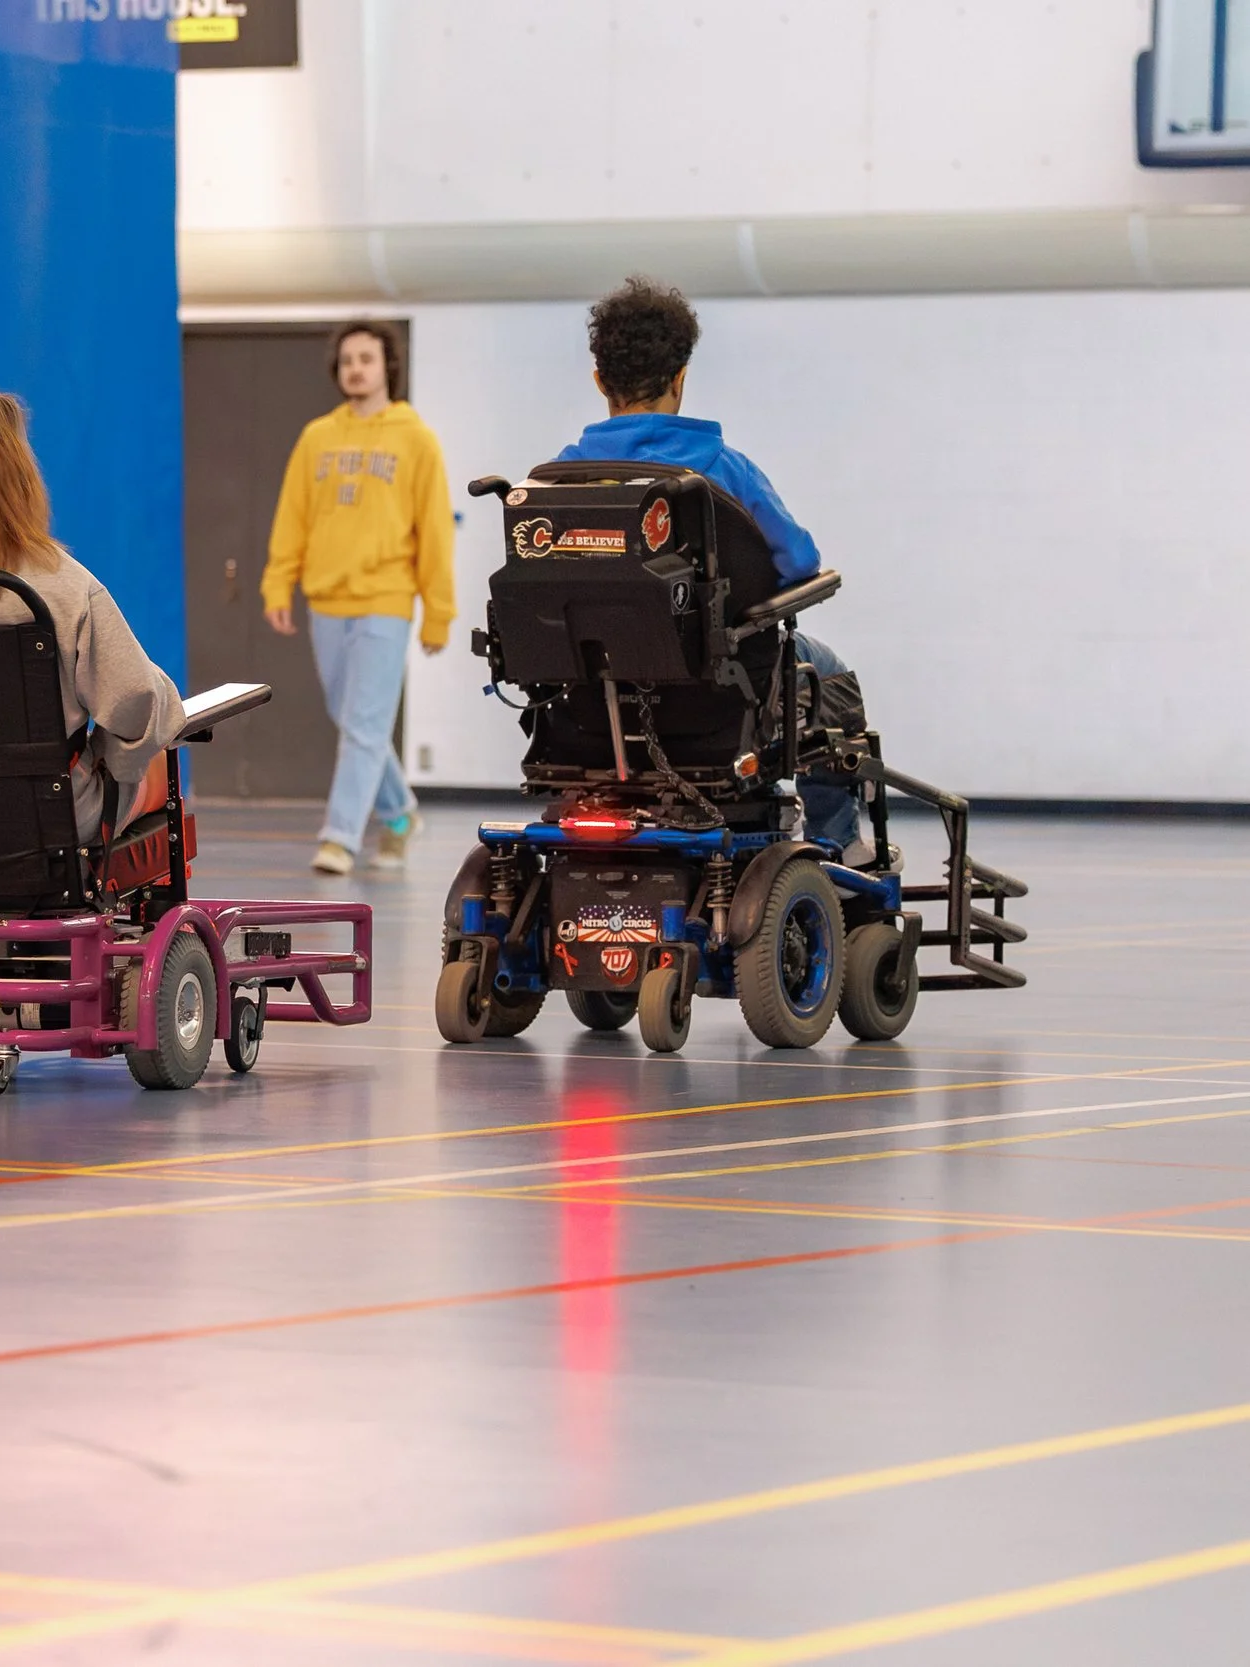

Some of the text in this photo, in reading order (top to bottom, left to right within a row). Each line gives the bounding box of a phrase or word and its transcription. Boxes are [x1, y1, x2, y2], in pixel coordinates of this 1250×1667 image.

[575, 536, 625, 547] BELIEVE!
[582, 918, 652, 928] NITRO CIRCUS
[603, 950, 631, 969] 707
